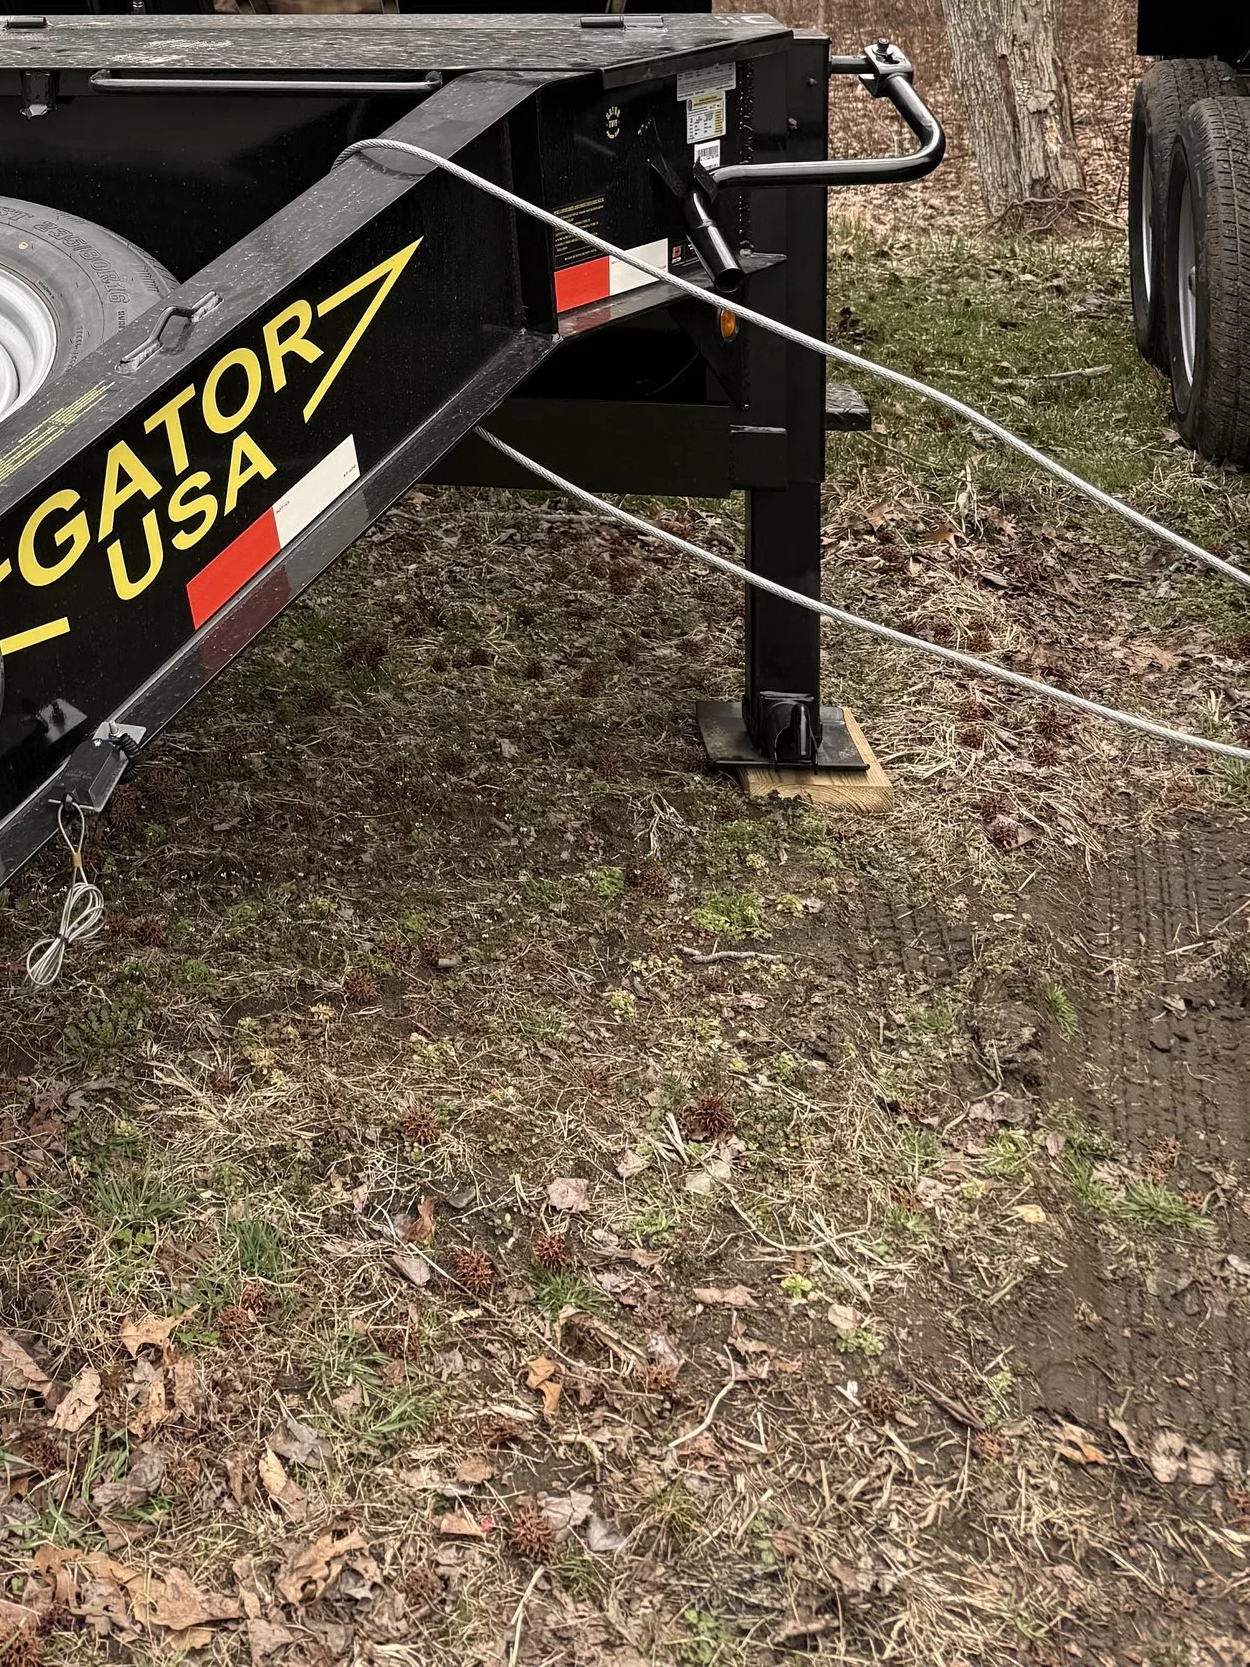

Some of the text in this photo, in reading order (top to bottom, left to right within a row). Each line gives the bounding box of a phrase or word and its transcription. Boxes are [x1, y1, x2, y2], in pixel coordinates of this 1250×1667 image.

[33, 220, 131, 304] 235/80R16
[18, 300, 324, 587] GATOR
[106, 431, 278, 601] USA
